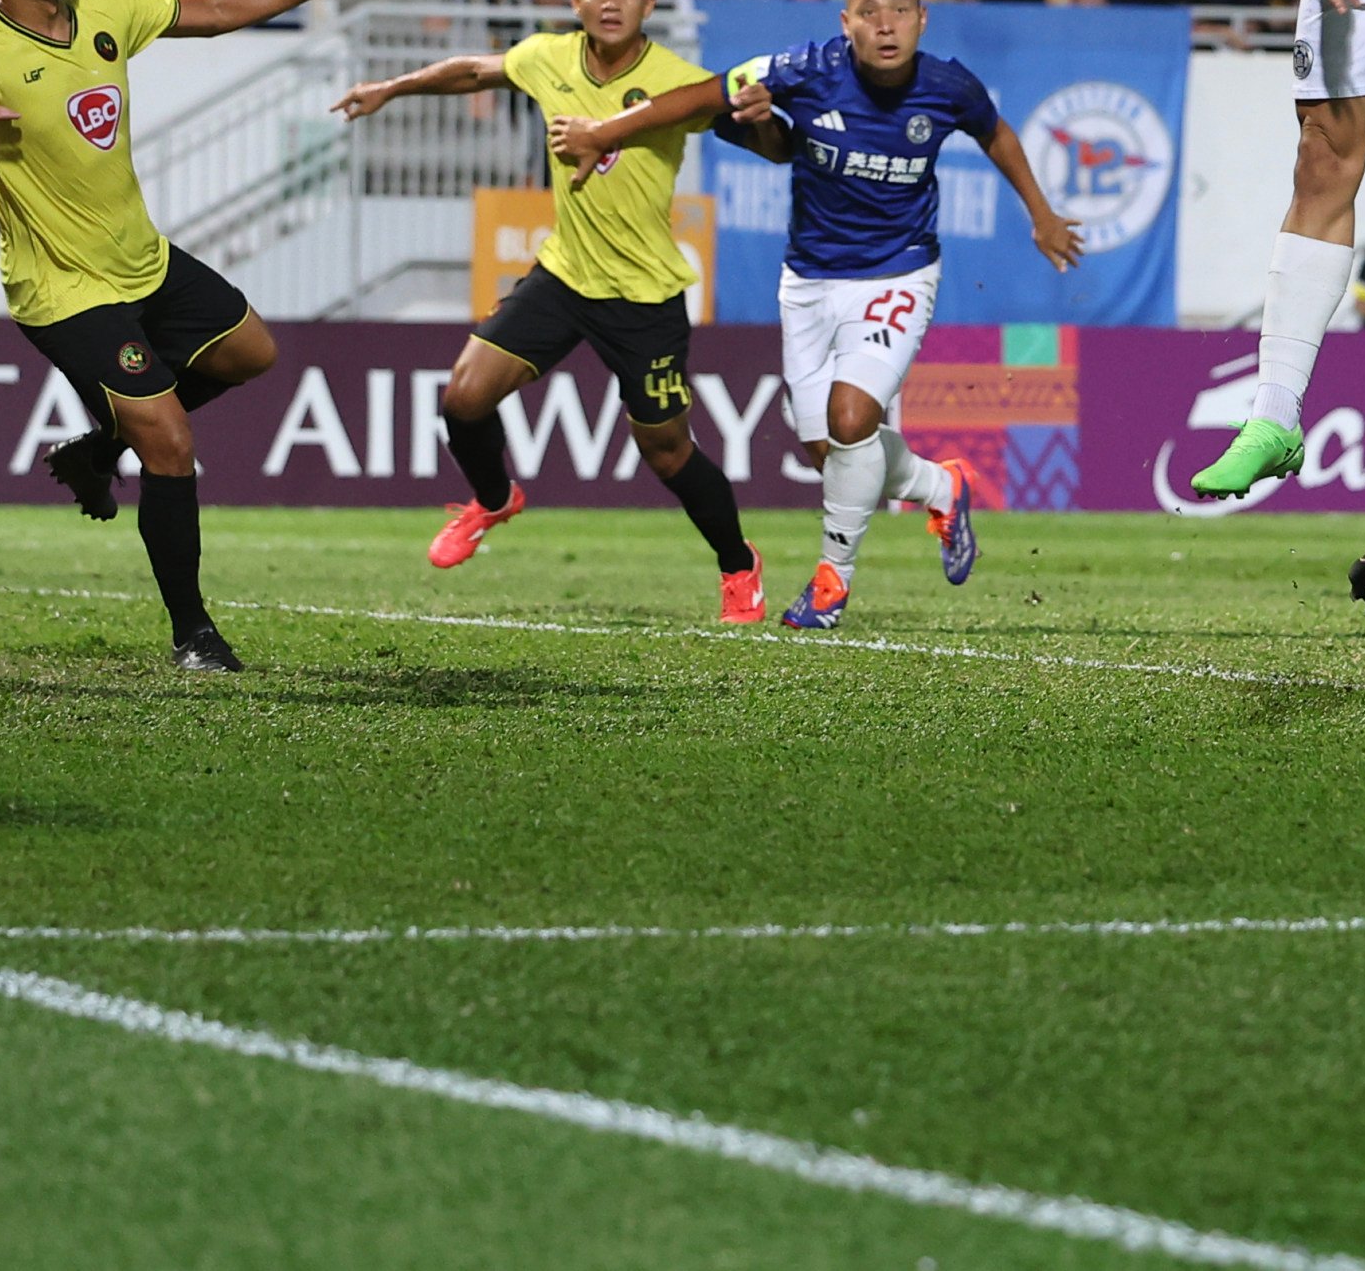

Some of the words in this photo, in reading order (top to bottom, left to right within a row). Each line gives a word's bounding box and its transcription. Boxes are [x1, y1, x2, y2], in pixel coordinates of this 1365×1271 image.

[77, 100, 117, 134] LBC
[864, 289, 917, 334] 22
[645, 369, 690, 409] 44
[262, 366, 823, 483] AIRWY
